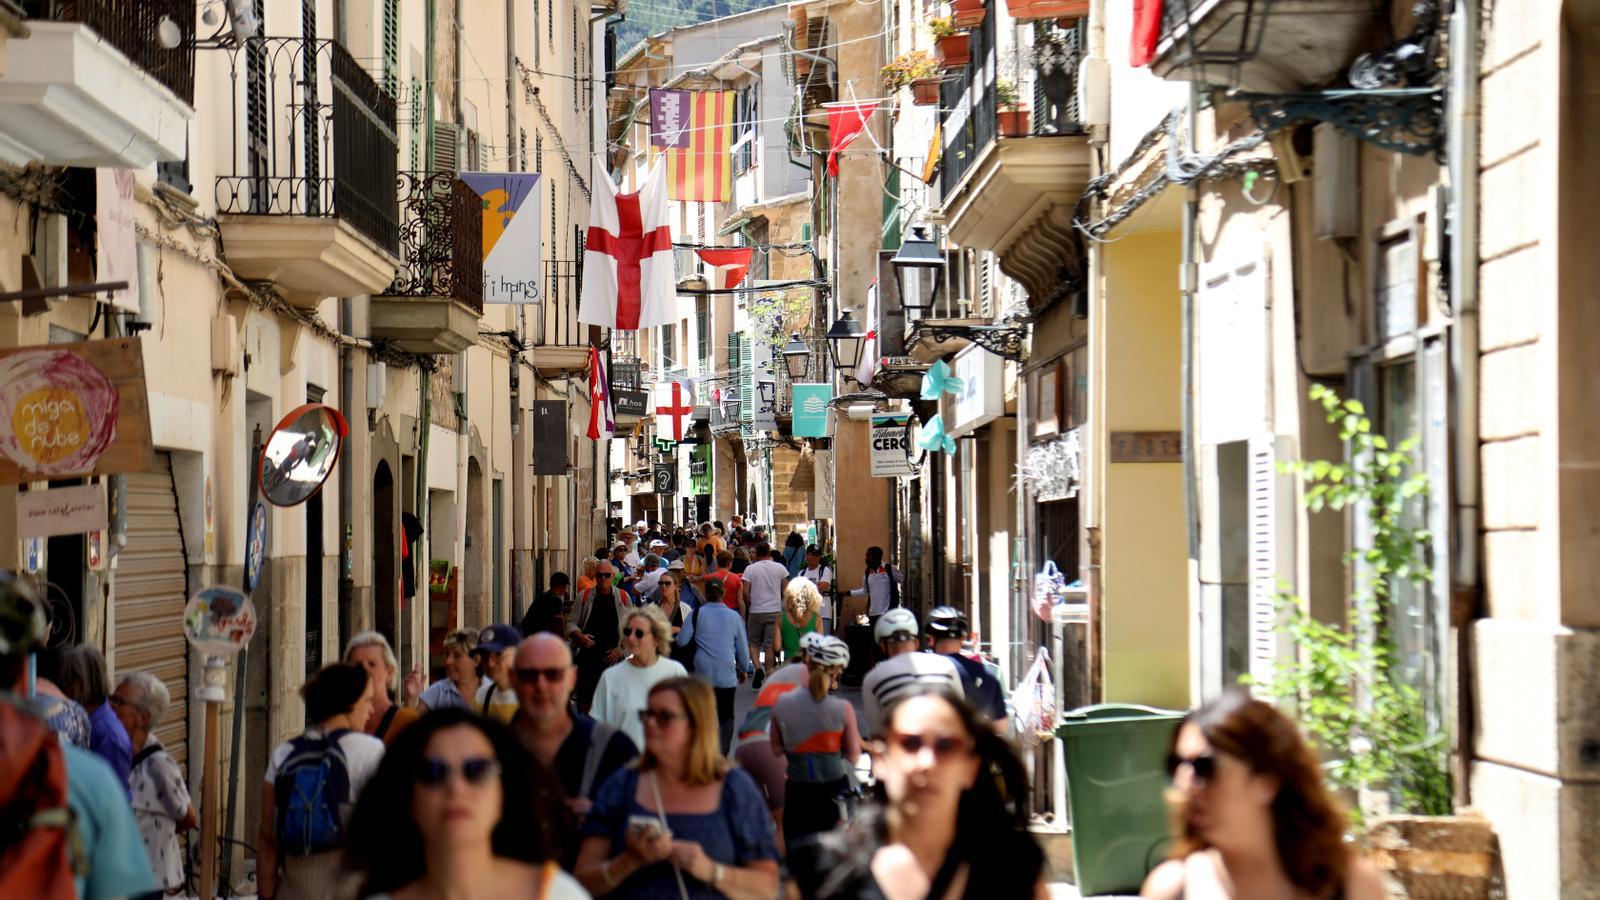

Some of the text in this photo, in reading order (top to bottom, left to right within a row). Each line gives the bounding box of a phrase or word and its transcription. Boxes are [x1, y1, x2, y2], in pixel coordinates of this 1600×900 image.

[22, 399, 75, 420] miga
[24, 414, 49, 437] de
[31, 425, 80, 448] nube
